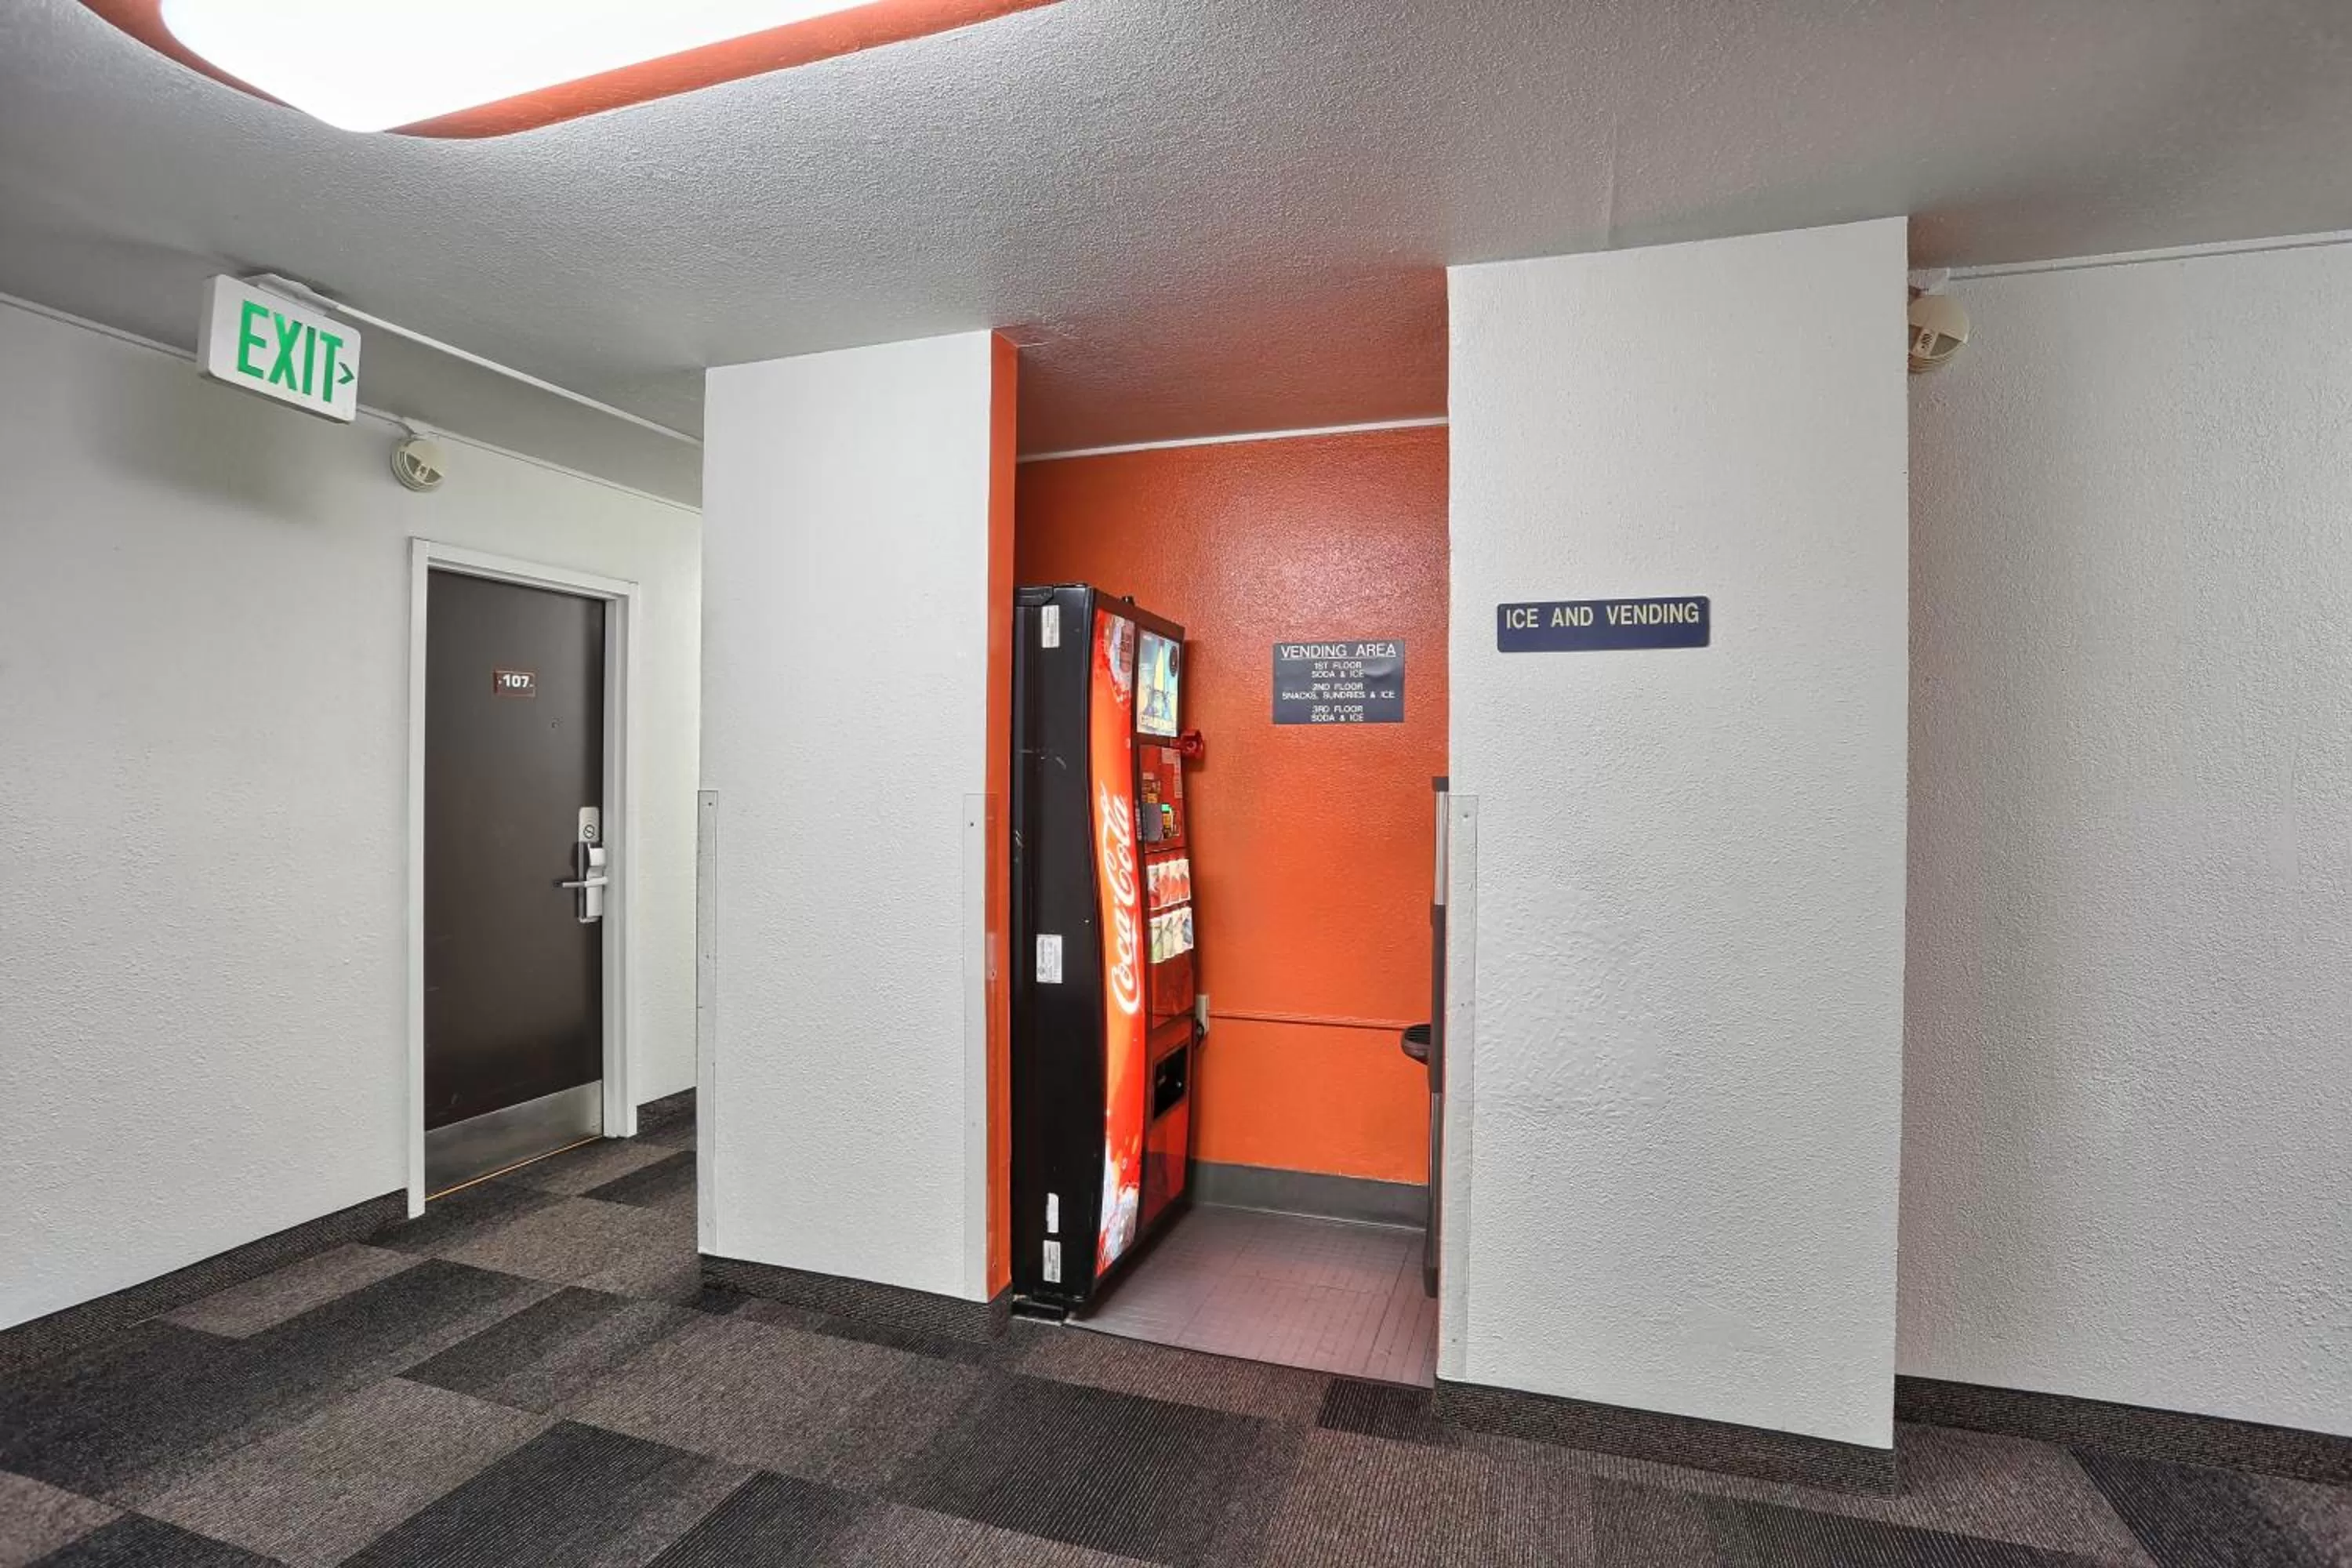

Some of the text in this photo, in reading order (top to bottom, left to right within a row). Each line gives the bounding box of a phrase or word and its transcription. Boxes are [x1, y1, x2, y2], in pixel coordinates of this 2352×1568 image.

[237, 299, 344, 404] EXIT
[1505, 602, 1700, 629] ICE AND VENDING
[1280, 644, 1396, 658] VENDING AREA
[1333, 661, 1362, 670] FLOOR
[503, 673, 530, 688] 107
[1349, 670, 1364, 678] ICE
[1323, 691, 1365, 700] SUNDRIES
